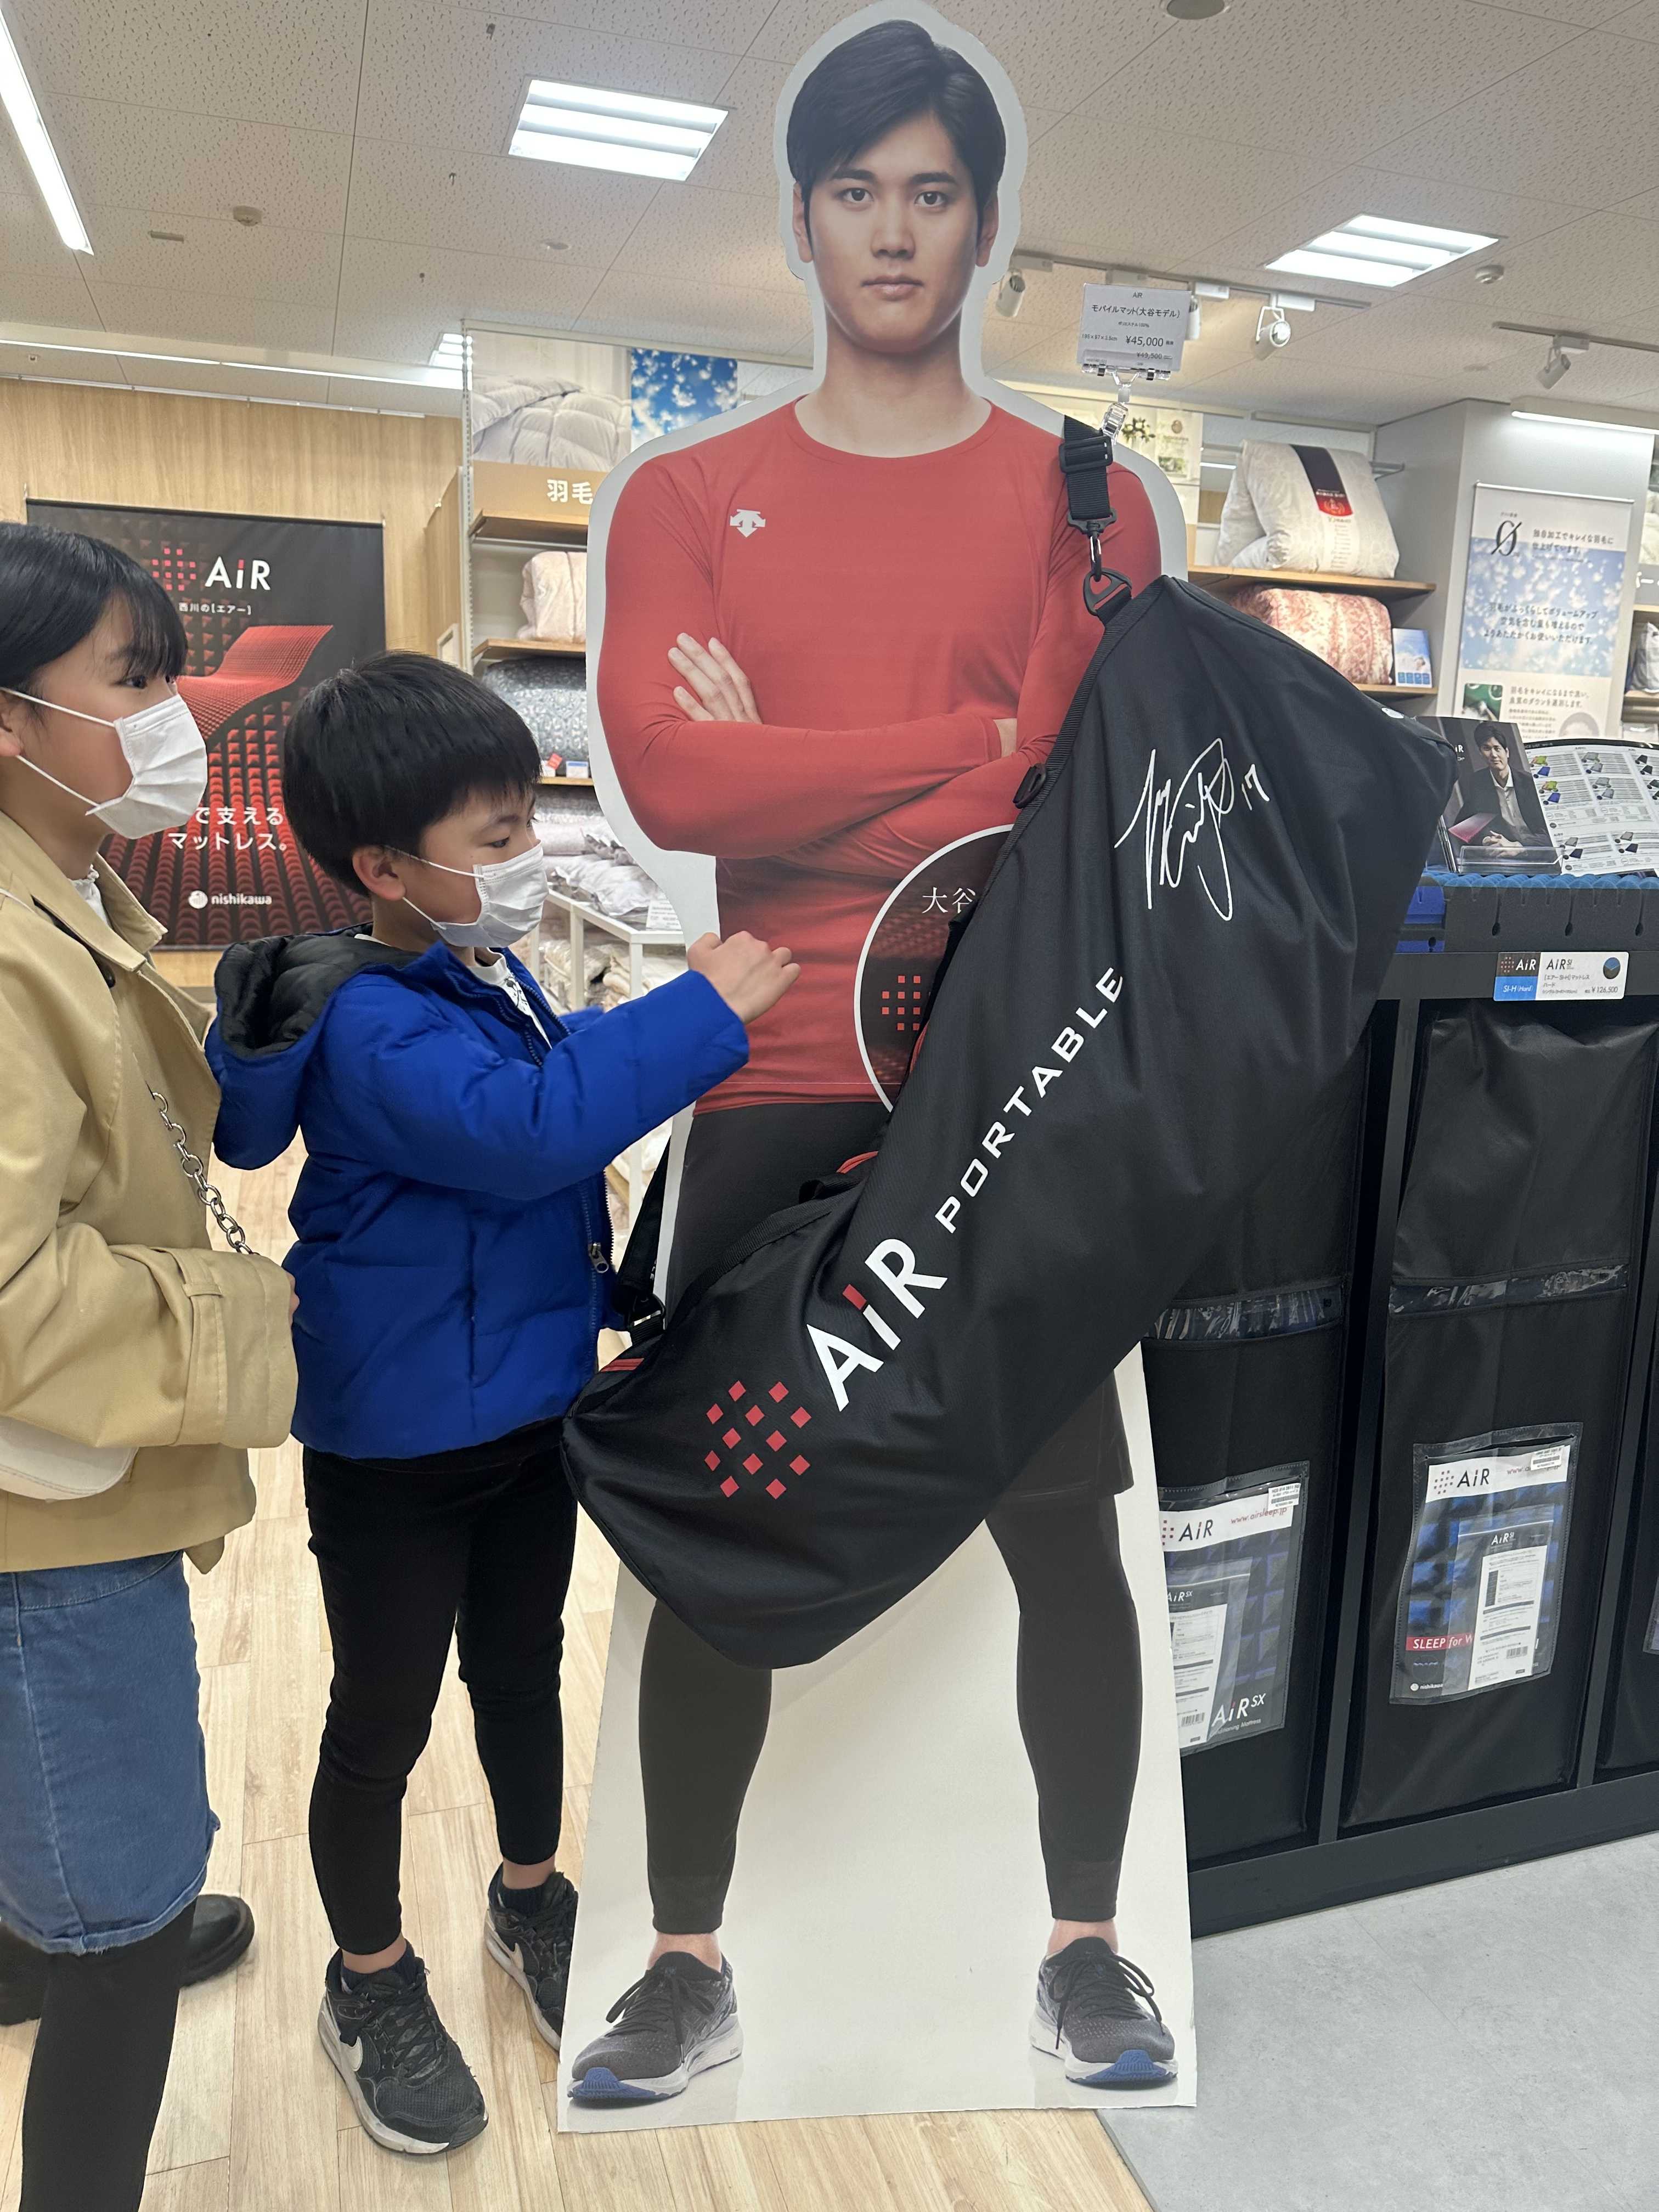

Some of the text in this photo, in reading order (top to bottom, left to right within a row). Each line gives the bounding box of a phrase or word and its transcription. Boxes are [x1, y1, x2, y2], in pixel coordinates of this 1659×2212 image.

[1092, 304, 1181, 318] モバイルマット(大谷モデル)
[1126, 335, 1164, 347] ¥45,000
[547, 479, 593, 505] 羽毛
[205, 556, 270, 590] AiR
[168, 832, 287, 851] マットレス。
[211, 893, 272, 905] nishikawa
[935, 967, 1123, 1234] PORTABLE
[806, 1238, 948, 1412] AiR
[1457, 1468, 1490, 1488] AiR
[1178, 1519, 1214, 1542] AiR
[1413, 1637, 1446, 1649] SLEEP
[1448, 1637, 1463, 1649] for
[1211, 1693, 1266, 1728] AiR SX
